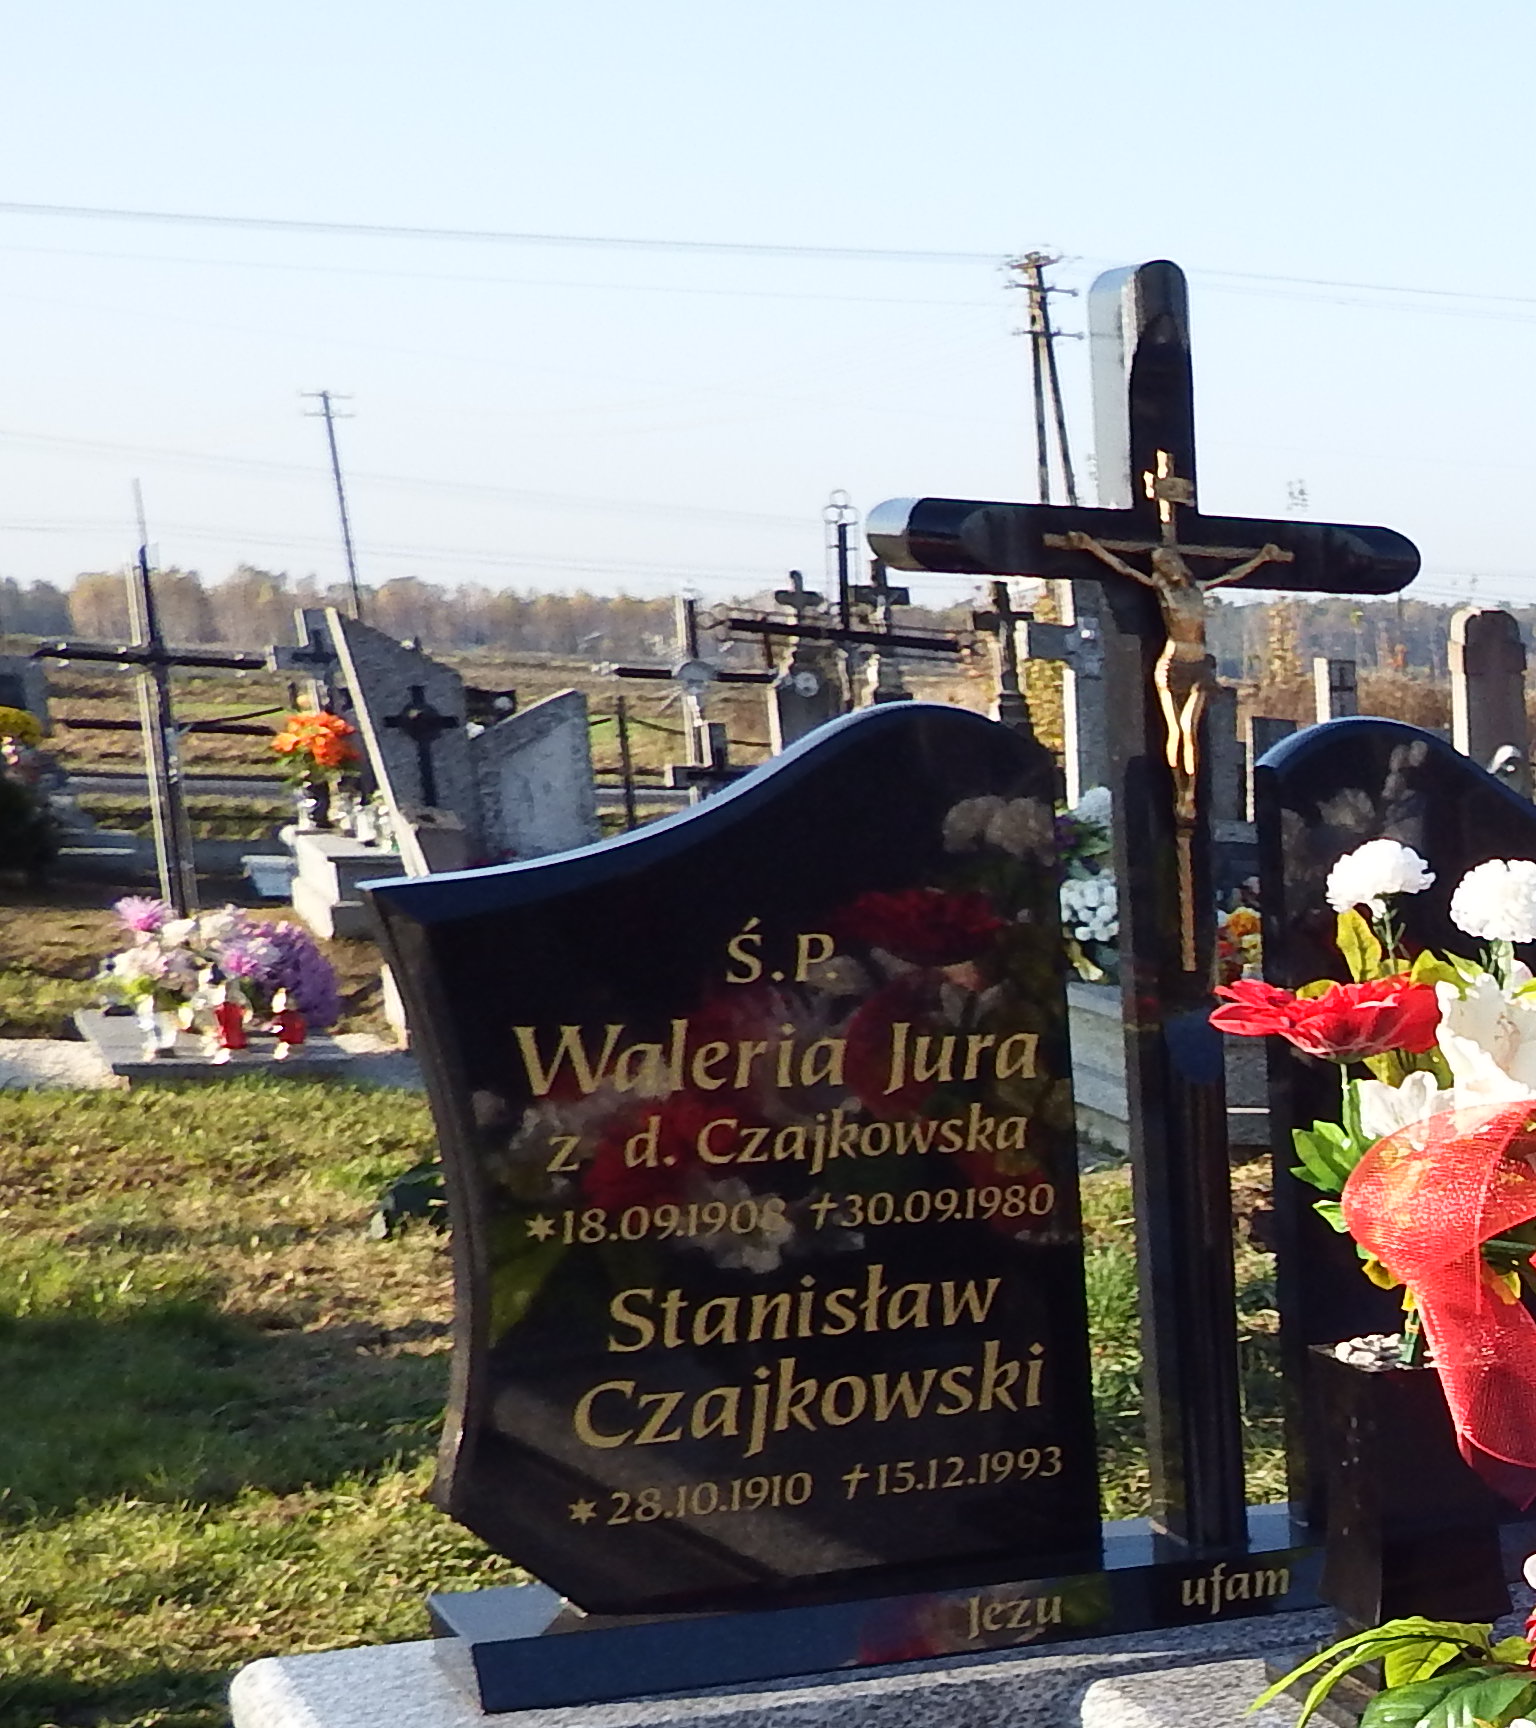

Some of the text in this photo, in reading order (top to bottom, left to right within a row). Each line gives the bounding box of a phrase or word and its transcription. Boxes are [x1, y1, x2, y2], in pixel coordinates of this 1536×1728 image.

[726, 917, 838, 984] Ś.P.
[512, 1018, 1040, 1097] Waleria Jura
[546, 1102, 1028, 1175] z d. Czajkowska
[607, 1263, 1001, 1353] Stanisław
[572, 1339, 1046, 1459] Czajkowski
[966, 1562, 1290, 1640] Jezu ufam
